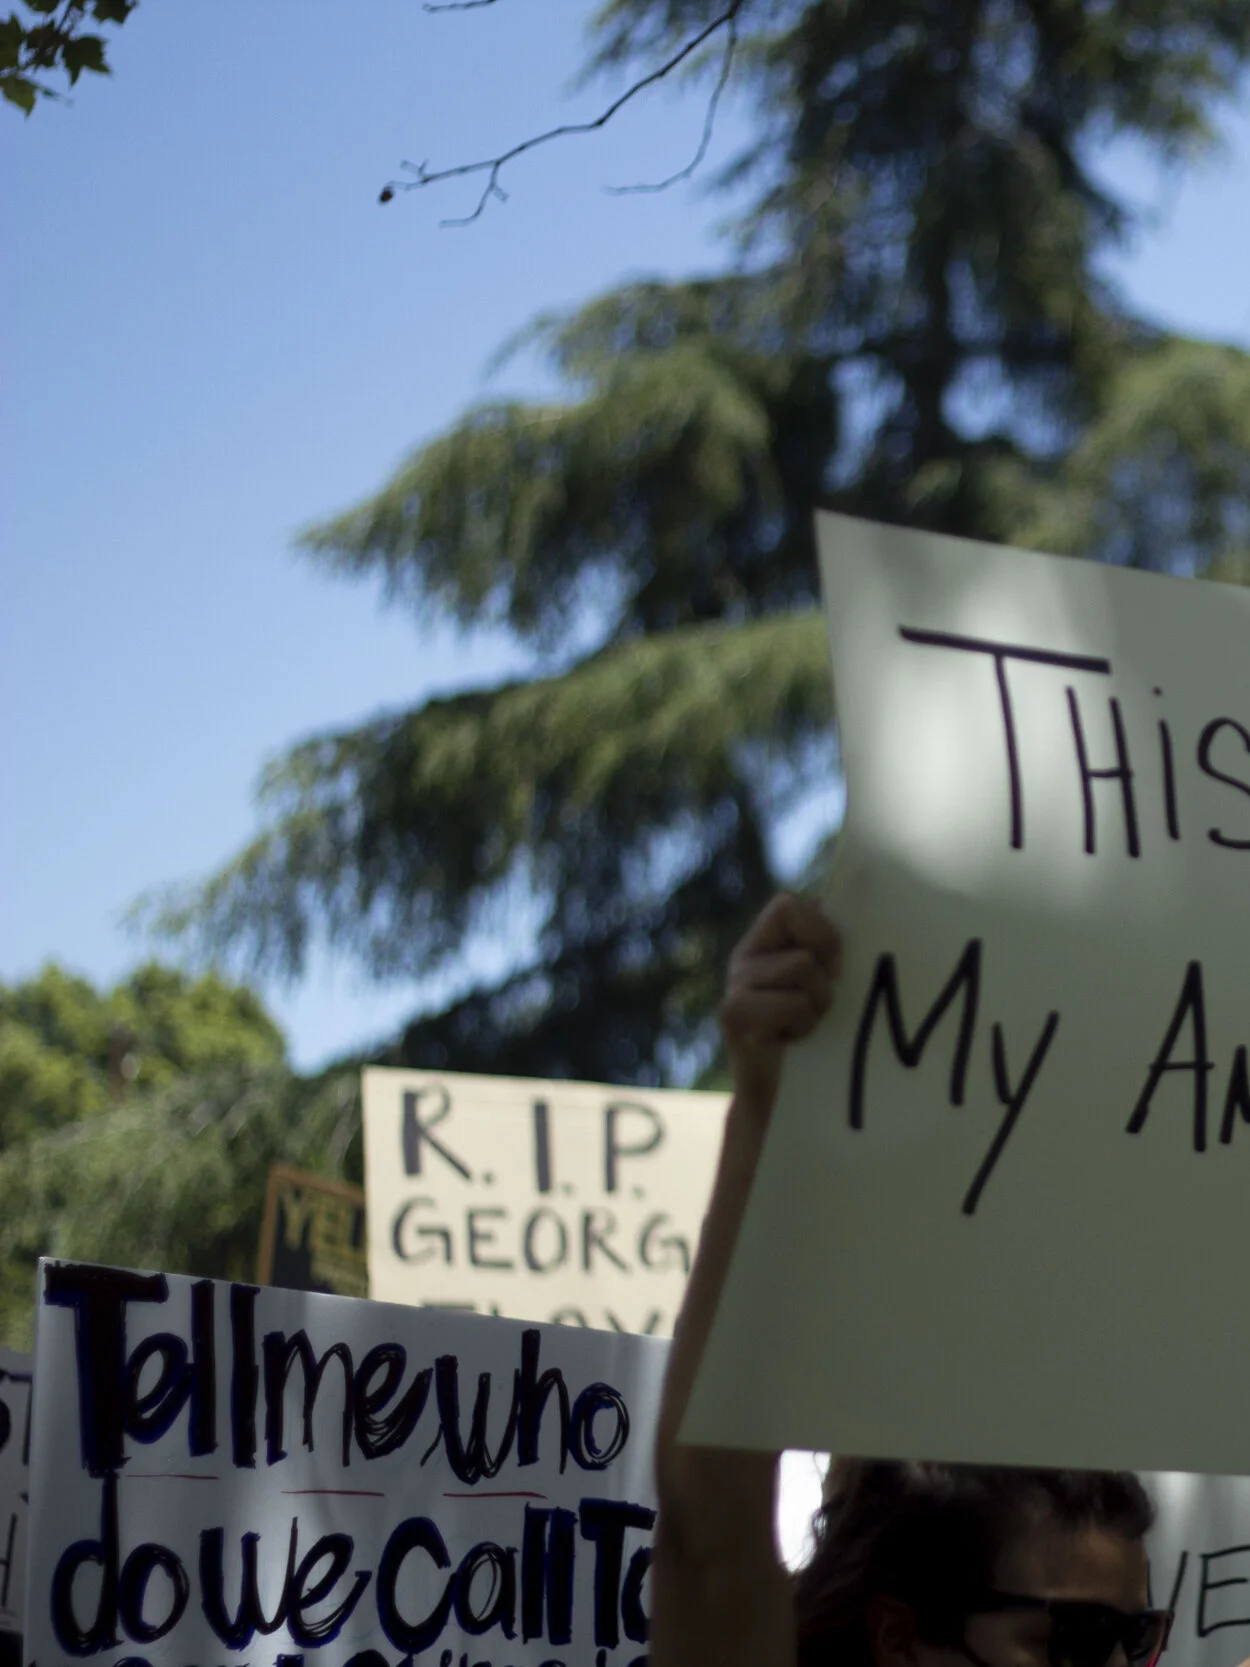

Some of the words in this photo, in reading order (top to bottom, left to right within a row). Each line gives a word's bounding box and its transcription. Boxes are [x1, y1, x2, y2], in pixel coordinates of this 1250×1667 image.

[848, 938, 1060, 1216] My
[44, 1260, 261, 1478] Tell
[262, 1329, 432, 1468] me
[420, 1328, 630, 1486] who
[50, 1470, 190, 1657] do
